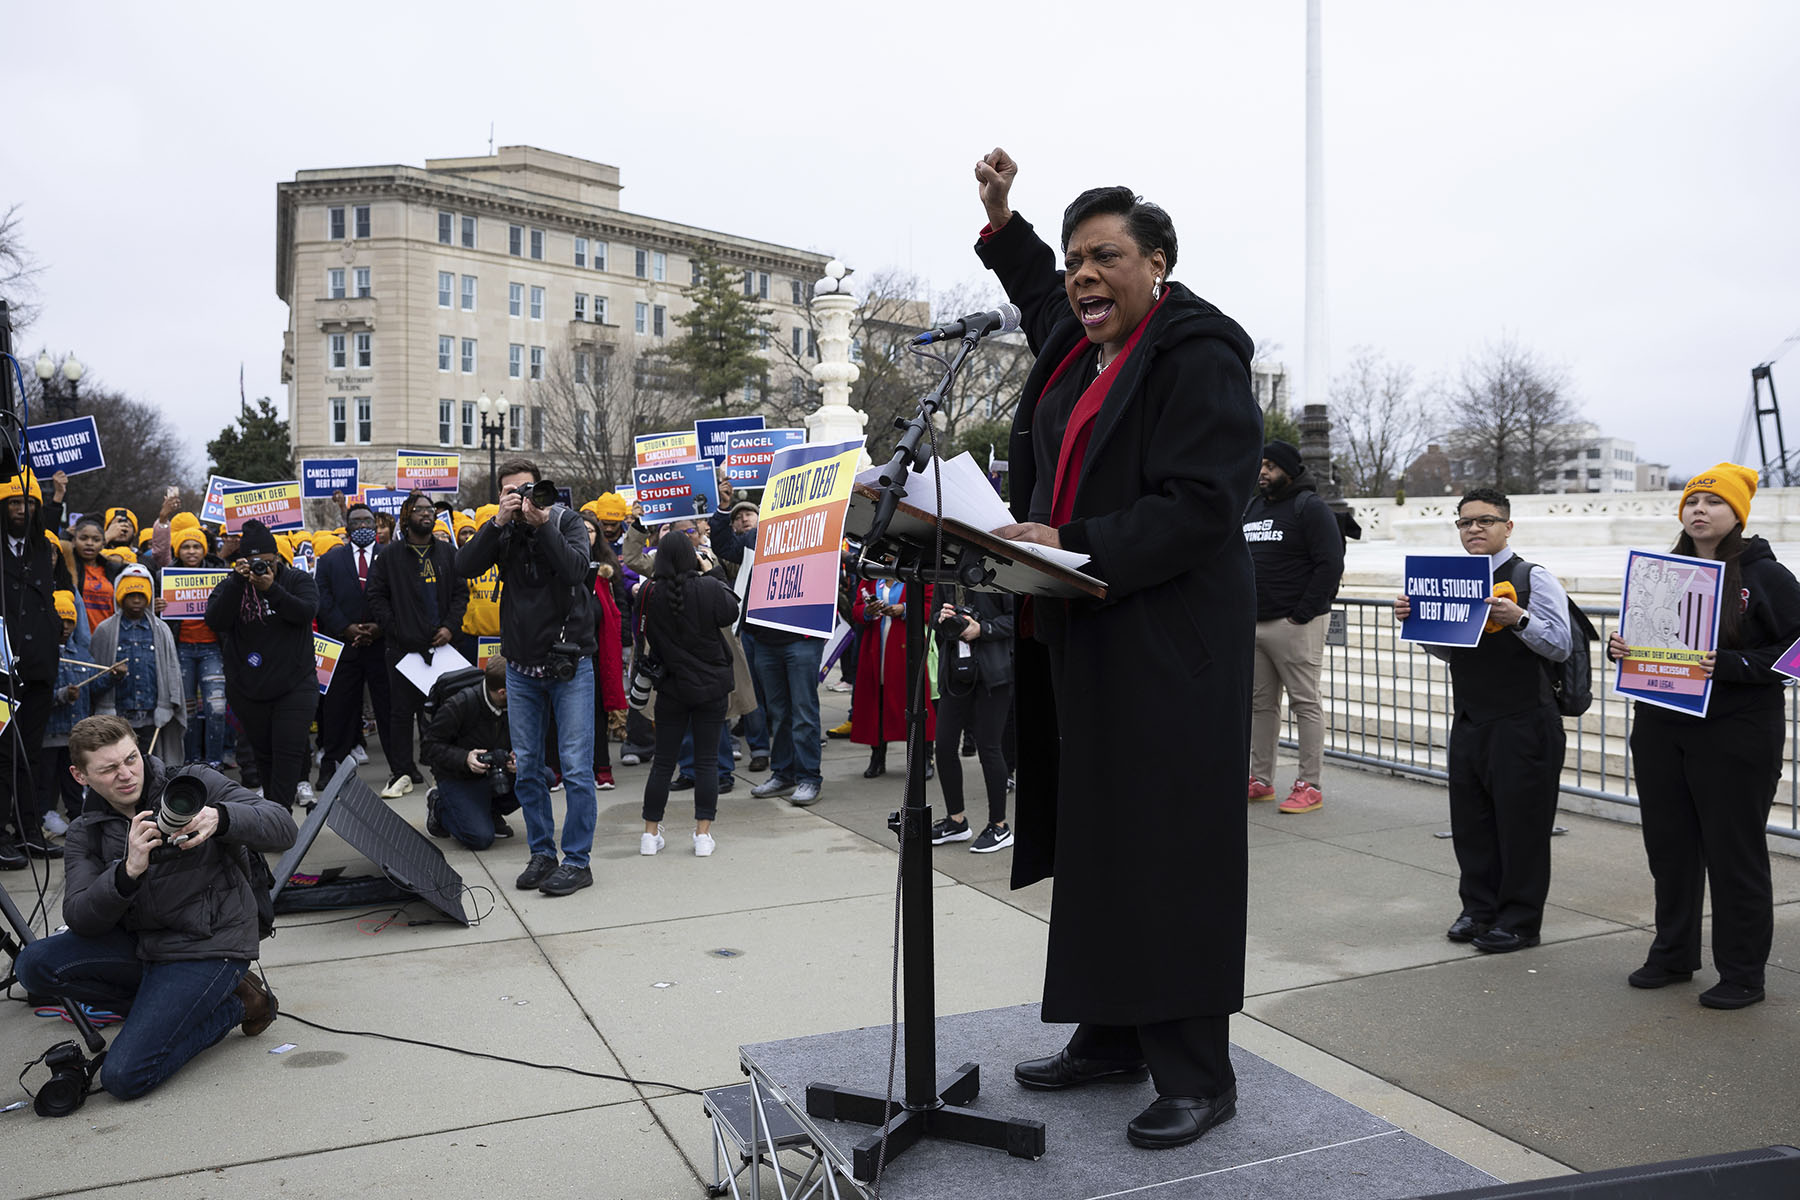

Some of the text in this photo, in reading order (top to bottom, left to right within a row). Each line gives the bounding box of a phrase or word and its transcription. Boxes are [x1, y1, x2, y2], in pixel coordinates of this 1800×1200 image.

[28, 431, 91, 454] NCEL STUDENT
[710, 432, 727, 443] OW!
[731, 437, 774, 449] CANCEL
[644, 437, 685, 451] STUDENT DEBT
[645, 447, 687, 462] CANCELLATION
[704, 445, 727, 456] TUDENT
[32, 448, 83, 468] DEBT NOW!
[406, 458, 448, 466] STUDENT DEBT
[730, 453, 775, 465] STUDENT
[307, 467, 355, 478] CANCEL STUDENT
[405, 468, 449, 477] CANCELLATION
[638, 471, 685, 484] CANCEL
[730, 469, 759, 479] DEBT
[315, 478, 348, 488] DEBT NOW!
[413, 479, 421, 487] IS
[771, 462, 840, 512] STUDENT DEBT
[233, 490, 267, 505] STUDENT
[269, 487, 287, 499] DEBT
[640, 486, 690, 499] STUDENT
[369, 497, 391, 507] CANCEL
[392, 496, 409, 505] STUD
[236, 499, 290, 517] CANCELLATION
[643, 502, 672, 514] DEBT
[1242, 520, 1263, 532] OUNG
[763, 510, 828, 557] CANCELLATION
[1243, 530, 1284, 542] VINCIBLES
[175, 576, 208, 587] STUDENT
[766, 563, 804, 601] IS LEGAL.
[1407, 577, 1484, 599] CANCEL STUDENT
[174, 588, 211, 601] CANCELLA
[186, 602, 195, 612] IS
[1419, 601, 1471, 623] DEBT NOW!
[314, 642, 329, 654] EBT
[1652, 650, 1665, 659] DEBT
[1666, 651, 1705, 662] CANCELLATION
[1637, 663, 1644, 672] IS
[1647, 679, 1658, 687] AND
